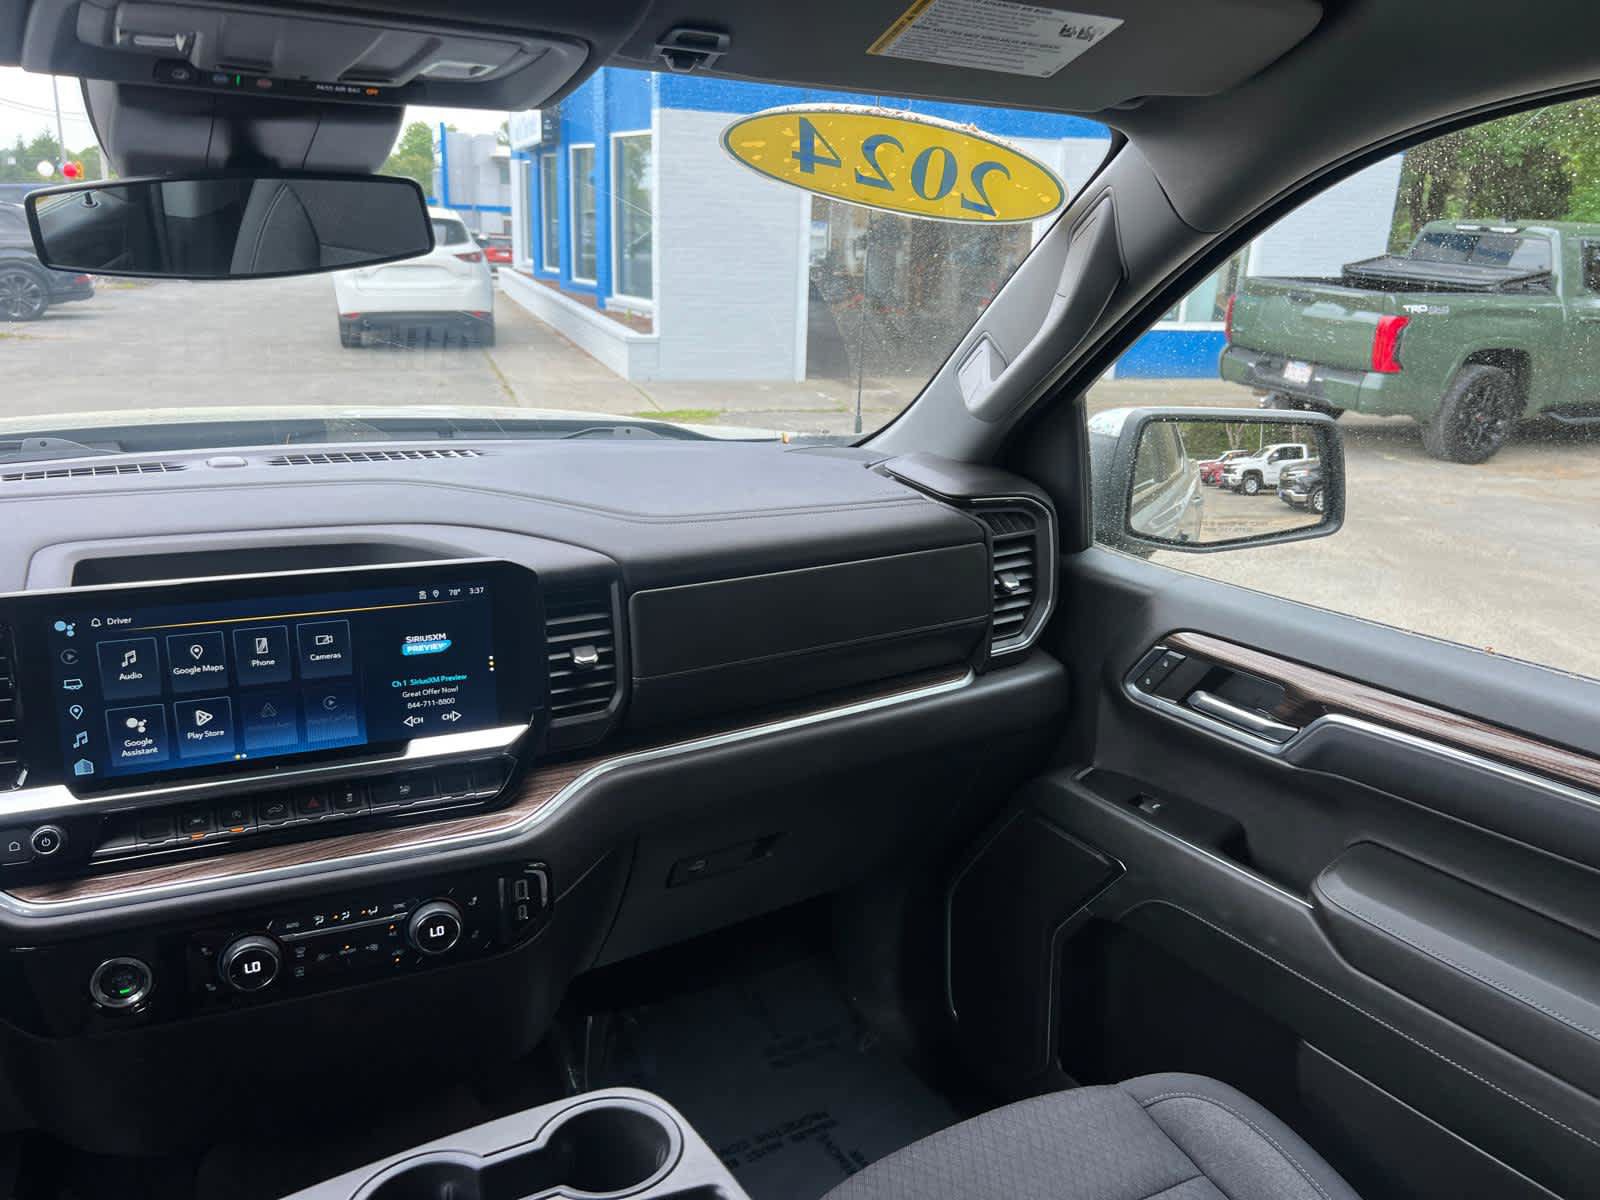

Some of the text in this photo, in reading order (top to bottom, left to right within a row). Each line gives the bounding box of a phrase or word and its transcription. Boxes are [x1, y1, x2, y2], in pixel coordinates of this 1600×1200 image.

[468, 586, 484, 594] 3:37
[106, 617, 132, 625] Driver
[405, 633, 447, 643] SIRIUSXM
[407, 642, 447, 652] PREVIEW
[309, 652, 342, 661] Cameras
[251, 659, 276, 667] Phone
[173, 664, 225, 675] Google Maps
[119, 672, 143, 681] Audio
[440, 674, 468, 682] Preview
[422, 688, 440, 696] Offer
[441, 684, 459, 694] Now!
[407, 697, 456, 709] 844-711-8800
[187, 732, 204, 740] Play
[124, 738, 153, 747] Google
[121, 746, 158, 757] Assistant
